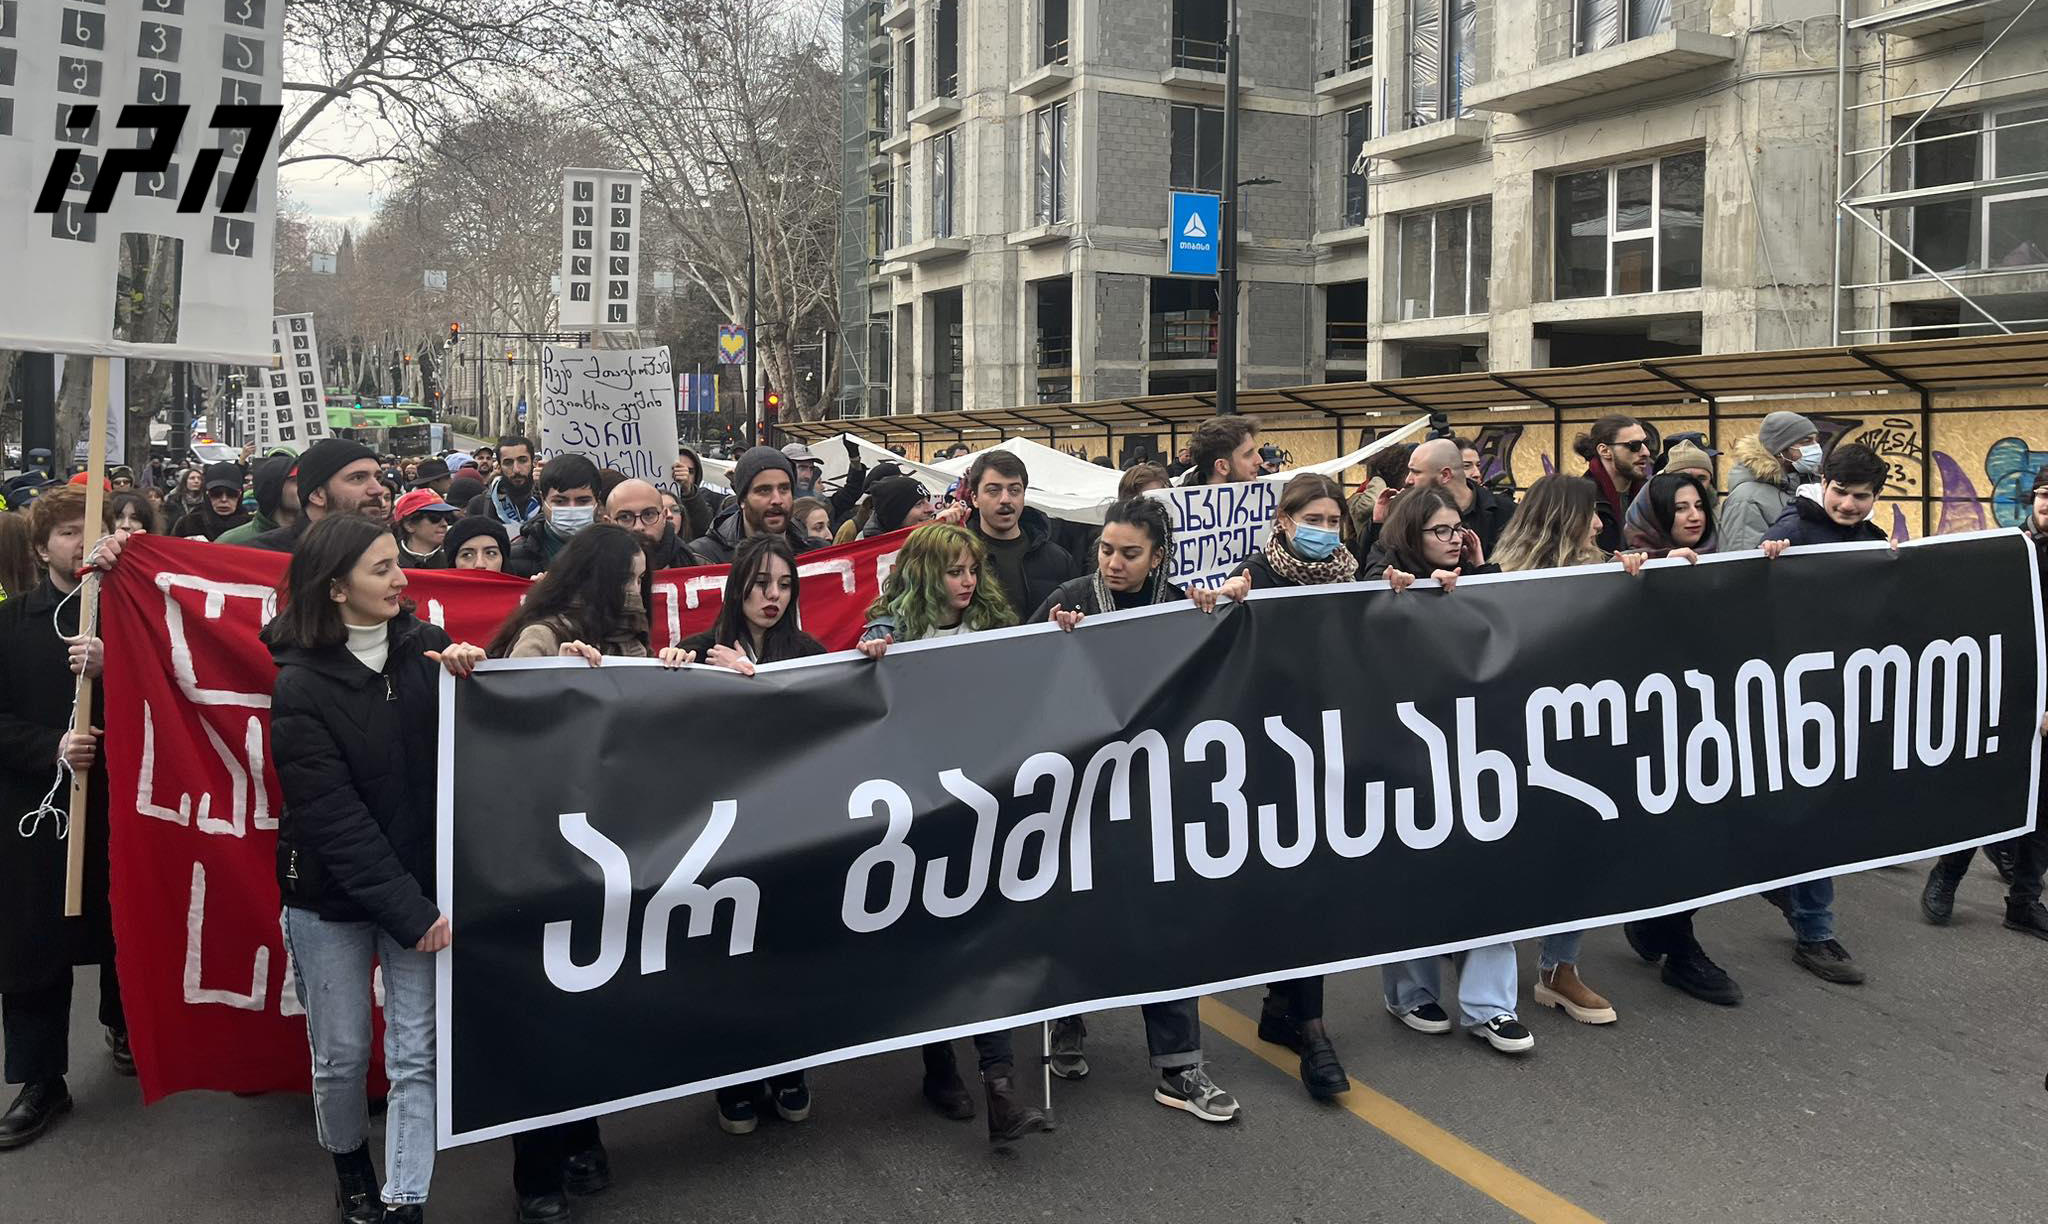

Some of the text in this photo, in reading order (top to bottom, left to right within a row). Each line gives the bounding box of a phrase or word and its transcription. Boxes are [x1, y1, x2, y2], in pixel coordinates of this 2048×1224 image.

[561, 421, 642, 448] ვართ
[543, 800, 760, 993] არ
[841, 634, 2004, 933] გამოვასახლებინოთ!
